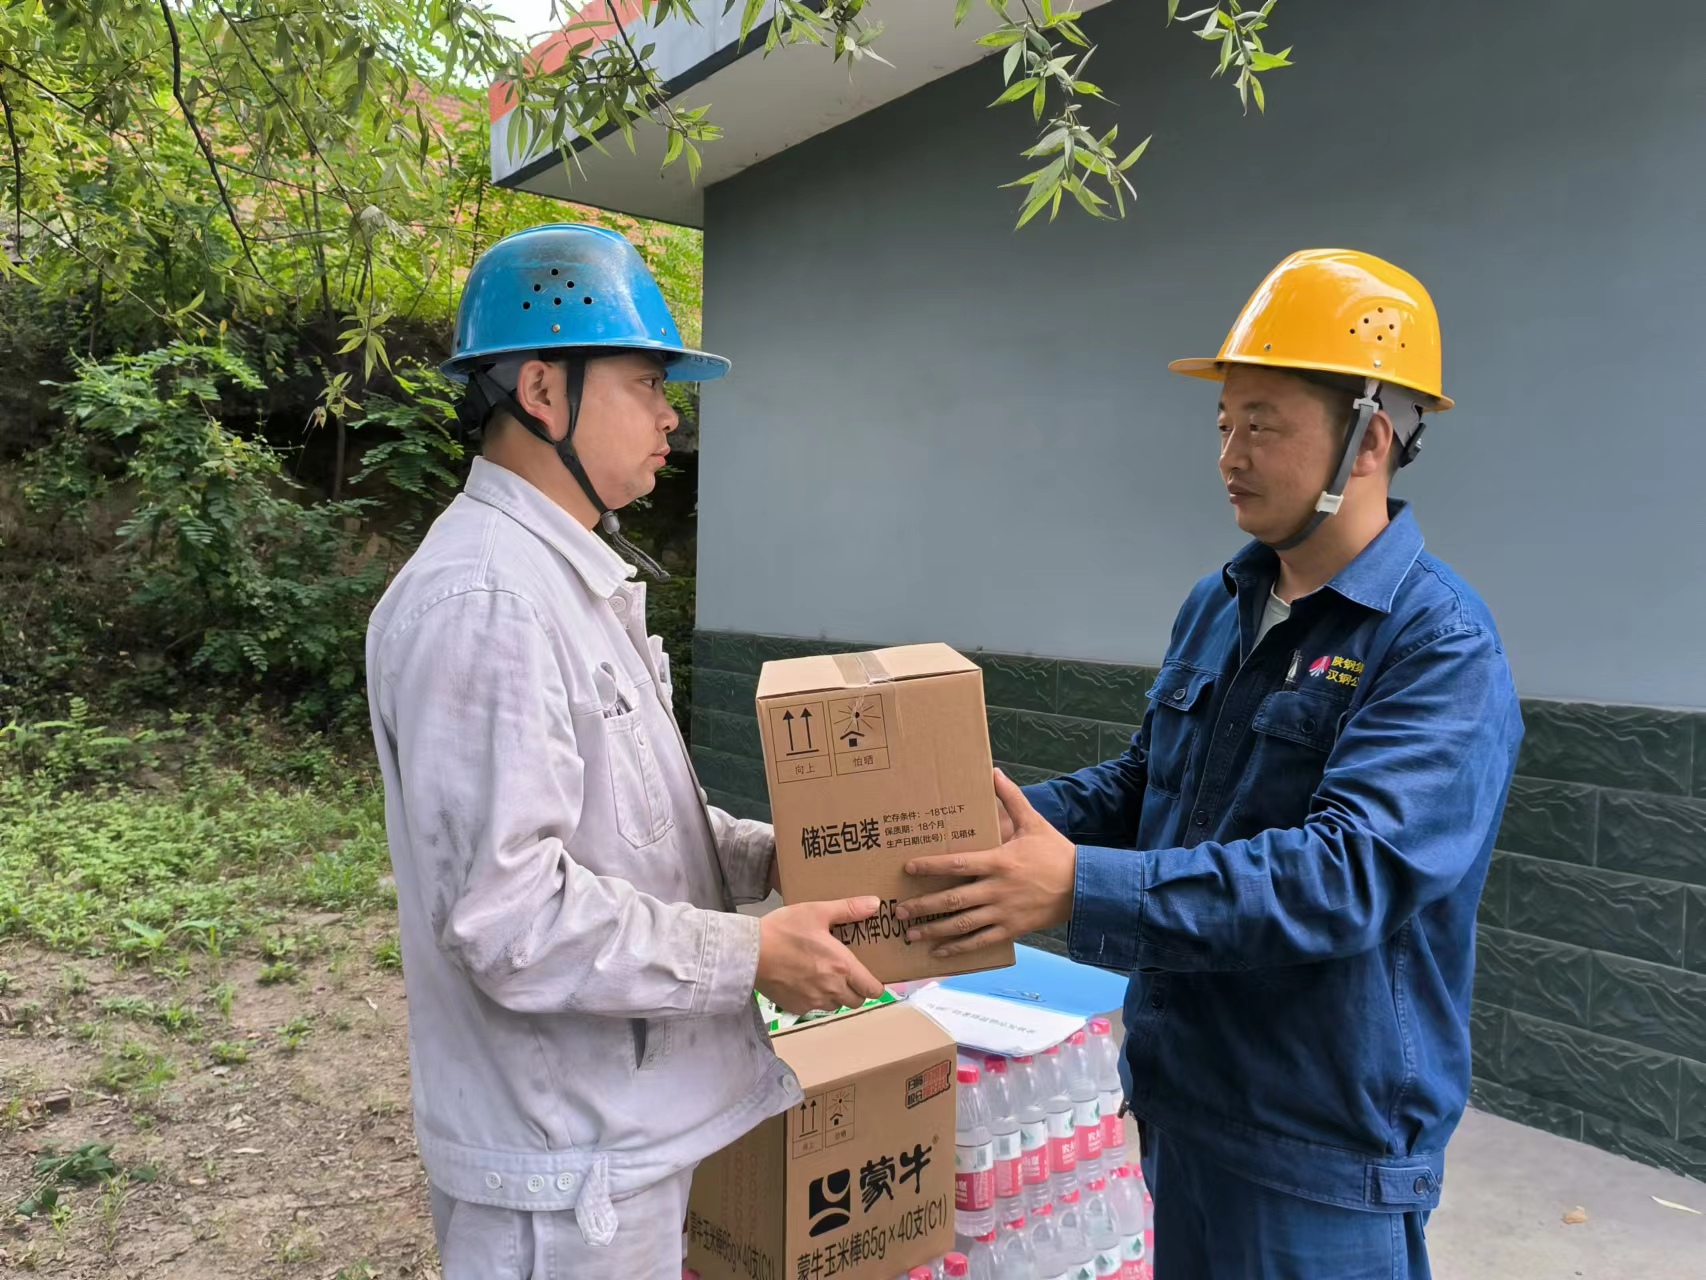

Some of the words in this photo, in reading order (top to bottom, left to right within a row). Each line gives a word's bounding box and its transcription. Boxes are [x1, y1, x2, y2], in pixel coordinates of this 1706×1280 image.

[795, 762, 816, 776] 向上
[853, 754, 874, 767] 怕晒
[801, 817, 881, 859] 储运包装
[859, 1143, 933, 1214] 蒙牛
